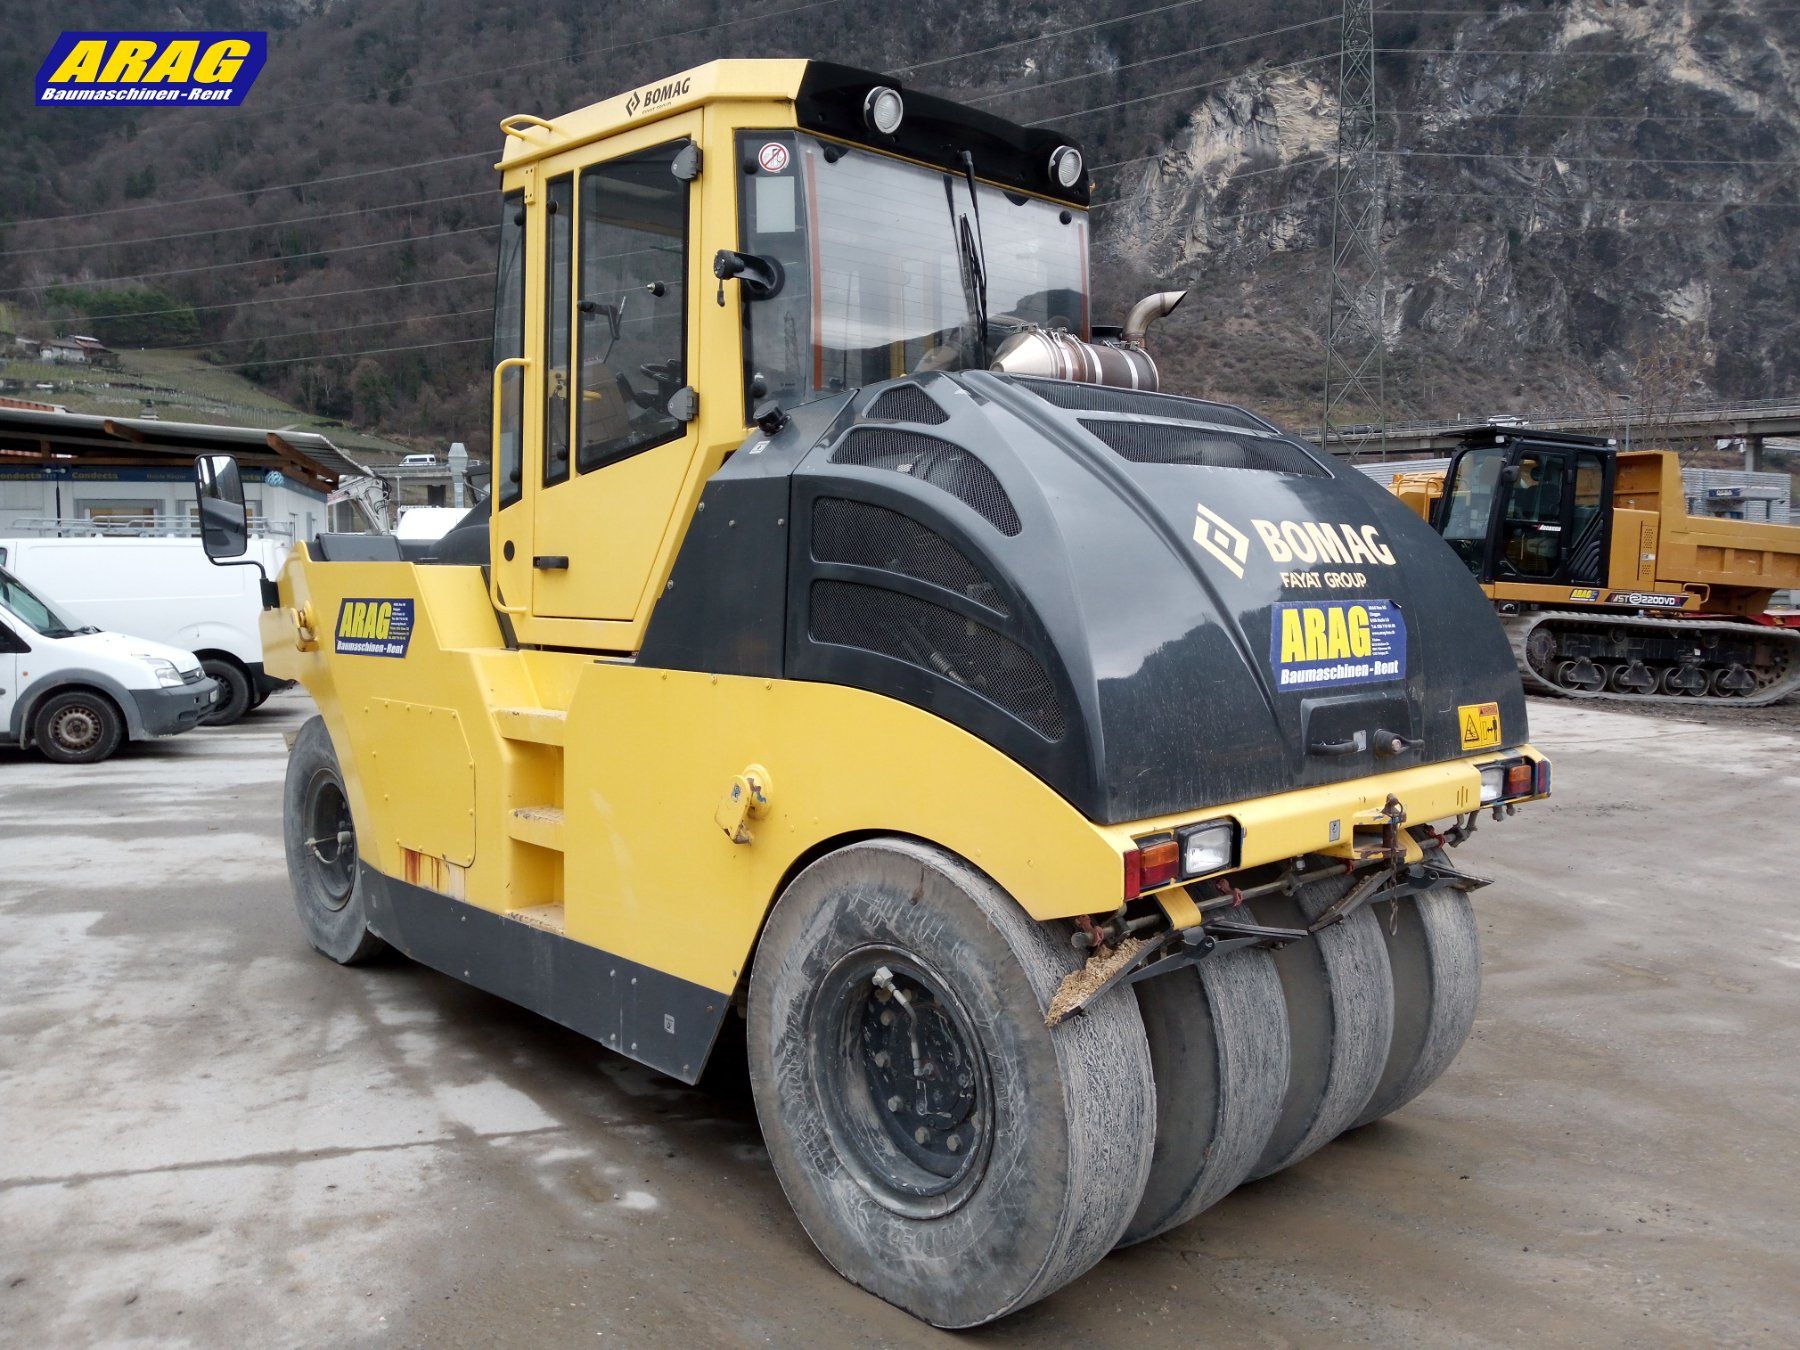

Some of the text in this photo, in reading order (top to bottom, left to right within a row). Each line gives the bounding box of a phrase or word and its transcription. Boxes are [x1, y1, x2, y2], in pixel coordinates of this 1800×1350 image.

[643, 77, 691, 108] BOMAG
[71, 471, 119, 480] Condecta
[1250, 518, 1397, 566] BOMAG
[1279, 571, 1367, 588] FAYAT GROUP
[338, 601, 392, 640] ARAG
[1280, 605, 1372, 663] ARAG
